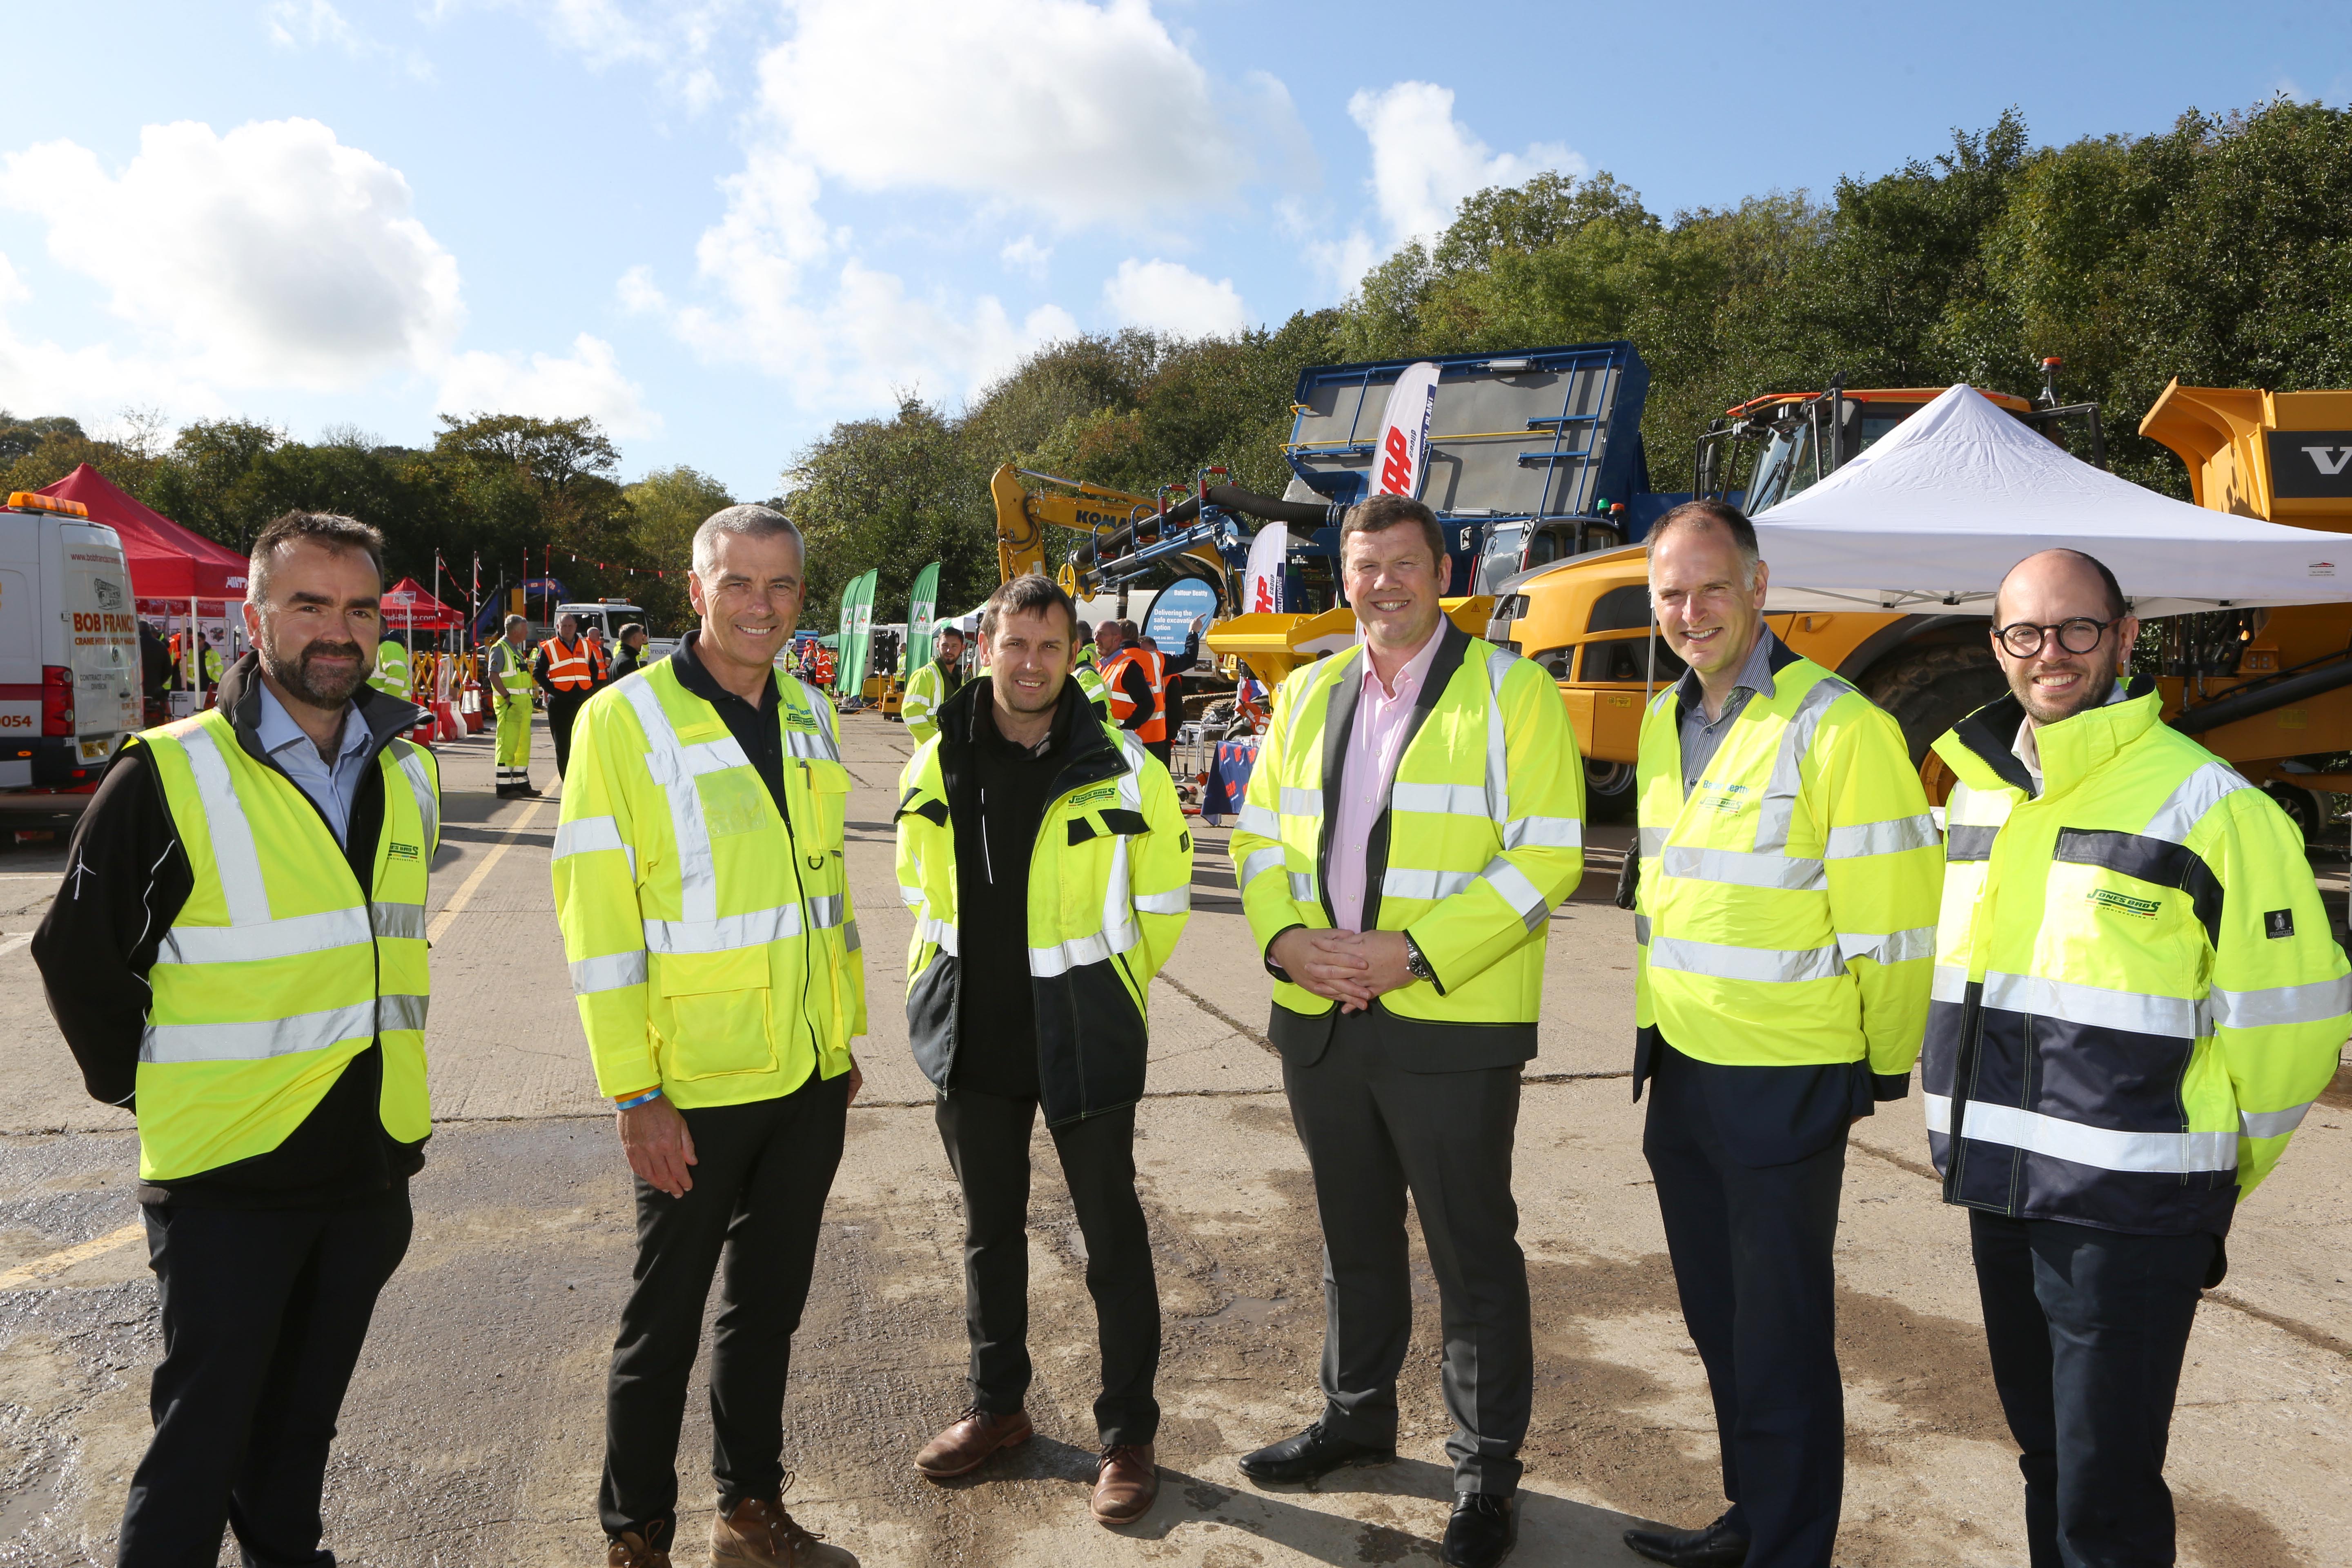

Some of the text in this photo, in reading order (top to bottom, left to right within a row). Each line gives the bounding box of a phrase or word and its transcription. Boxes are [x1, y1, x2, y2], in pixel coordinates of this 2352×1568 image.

[1425, 396, 1434, 426] PLANT
[1075, 510, 1131, 528] KOMA
[1154, 609, 1183, 617] Delivering
[73, 612, 102, 633] BOB
[75, 637, 94, 646] CRANE
[0, 715, 33, 728] 054
[1069, 788, 1116, 804] JONES BROS
[2087, 889, 2162, 913] JONES BROS
[2103, 907, 2146, 919] ENGINEERING
